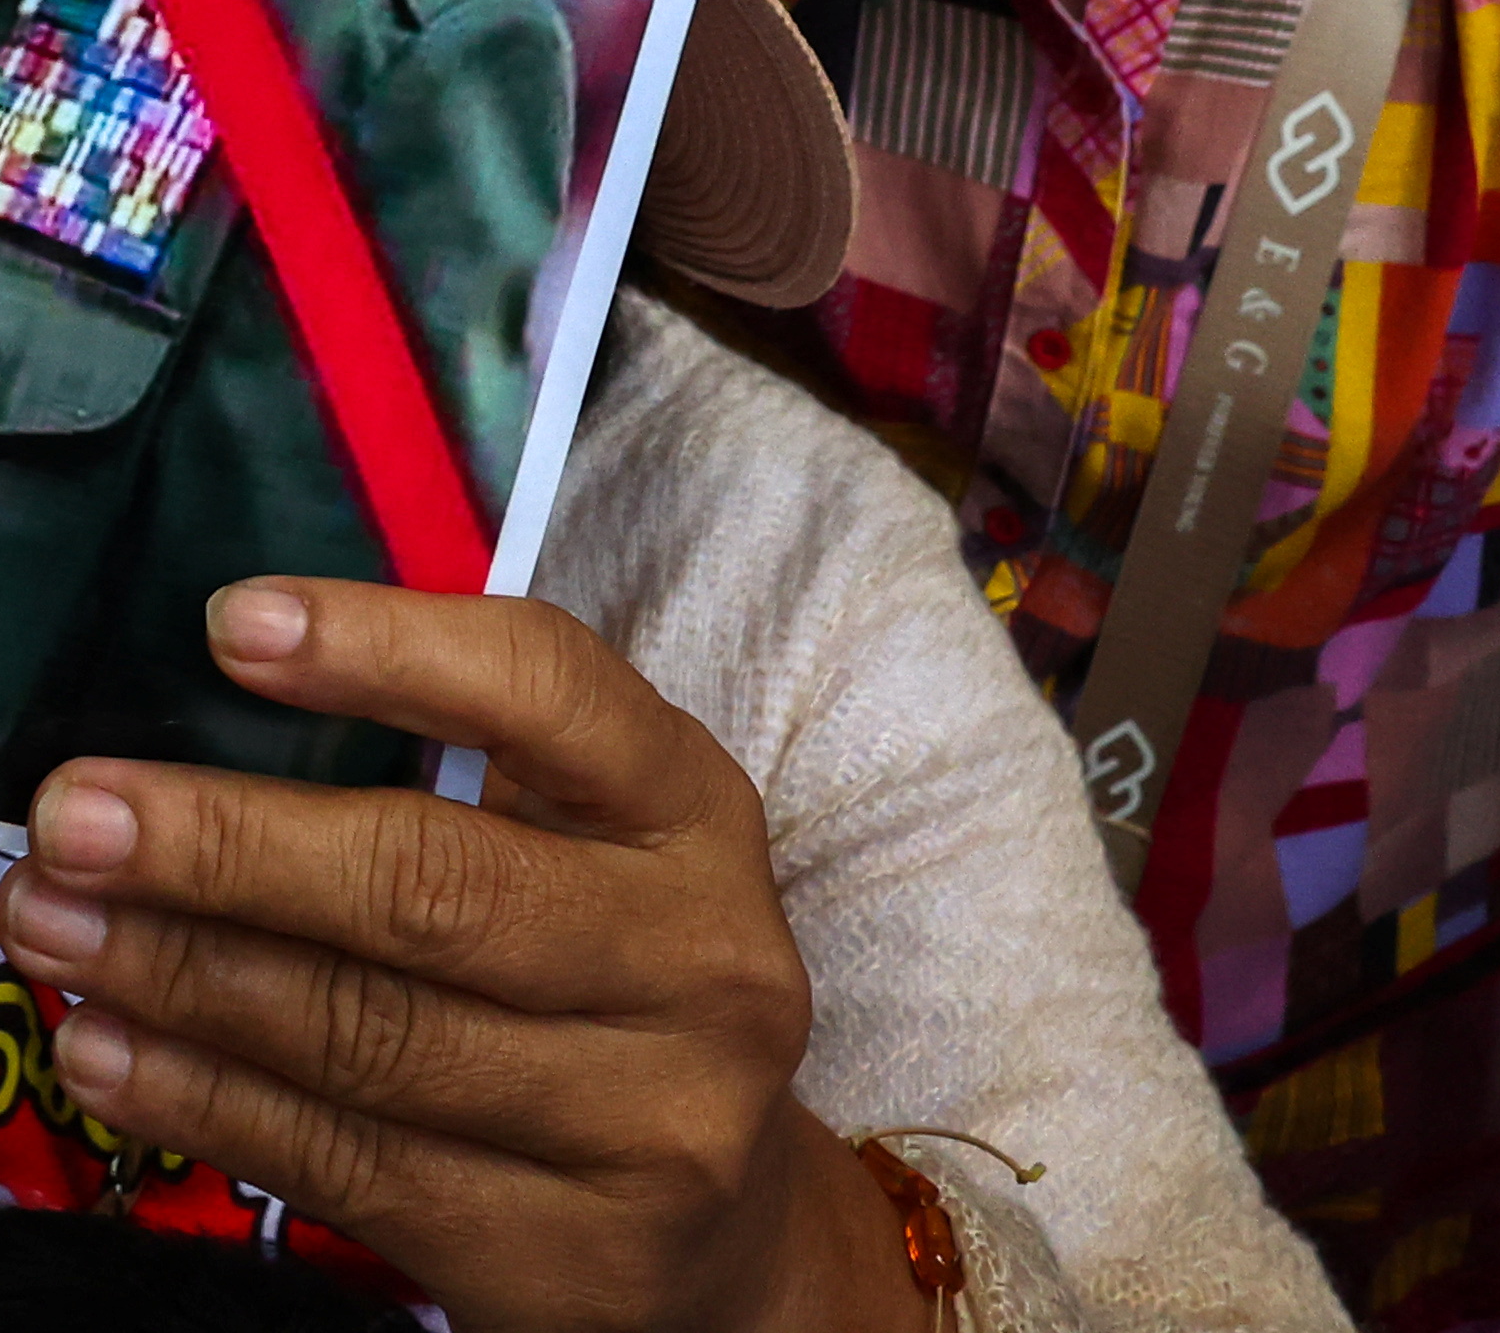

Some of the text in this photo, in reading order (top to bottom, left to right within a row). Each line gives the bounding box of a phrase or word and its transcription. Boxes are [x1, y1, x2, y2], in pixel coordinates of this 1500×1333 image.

[1223, 236, 1302, 377] E & G
